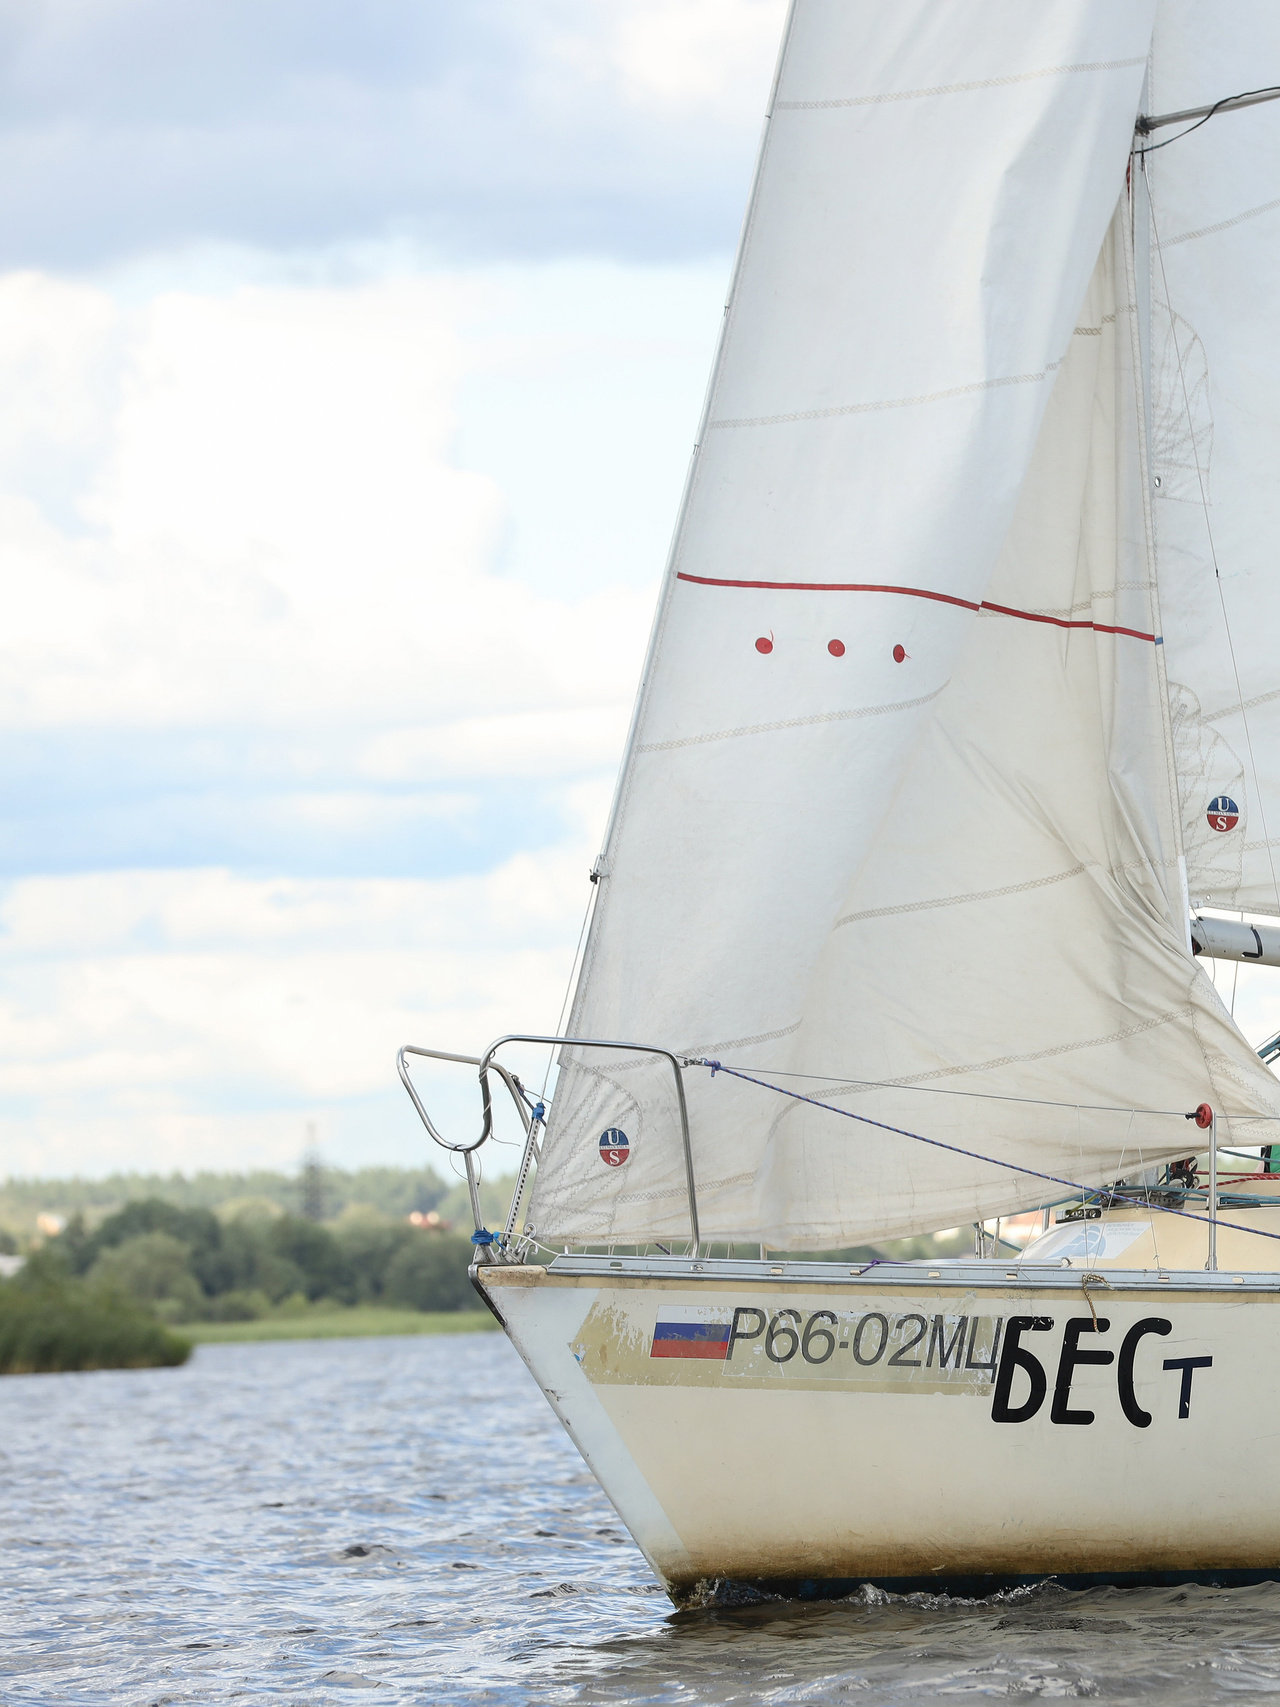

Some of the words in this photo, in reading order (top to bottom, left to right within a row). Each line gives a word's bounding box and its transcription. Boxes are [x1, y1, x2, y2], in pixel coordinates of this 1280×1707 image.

[1217, 798, 1230, 812] U
[1216, 816, 1227, 831] S
[607, 1130, 620, 1145] U
[609, 1150, 620, 1165] S
